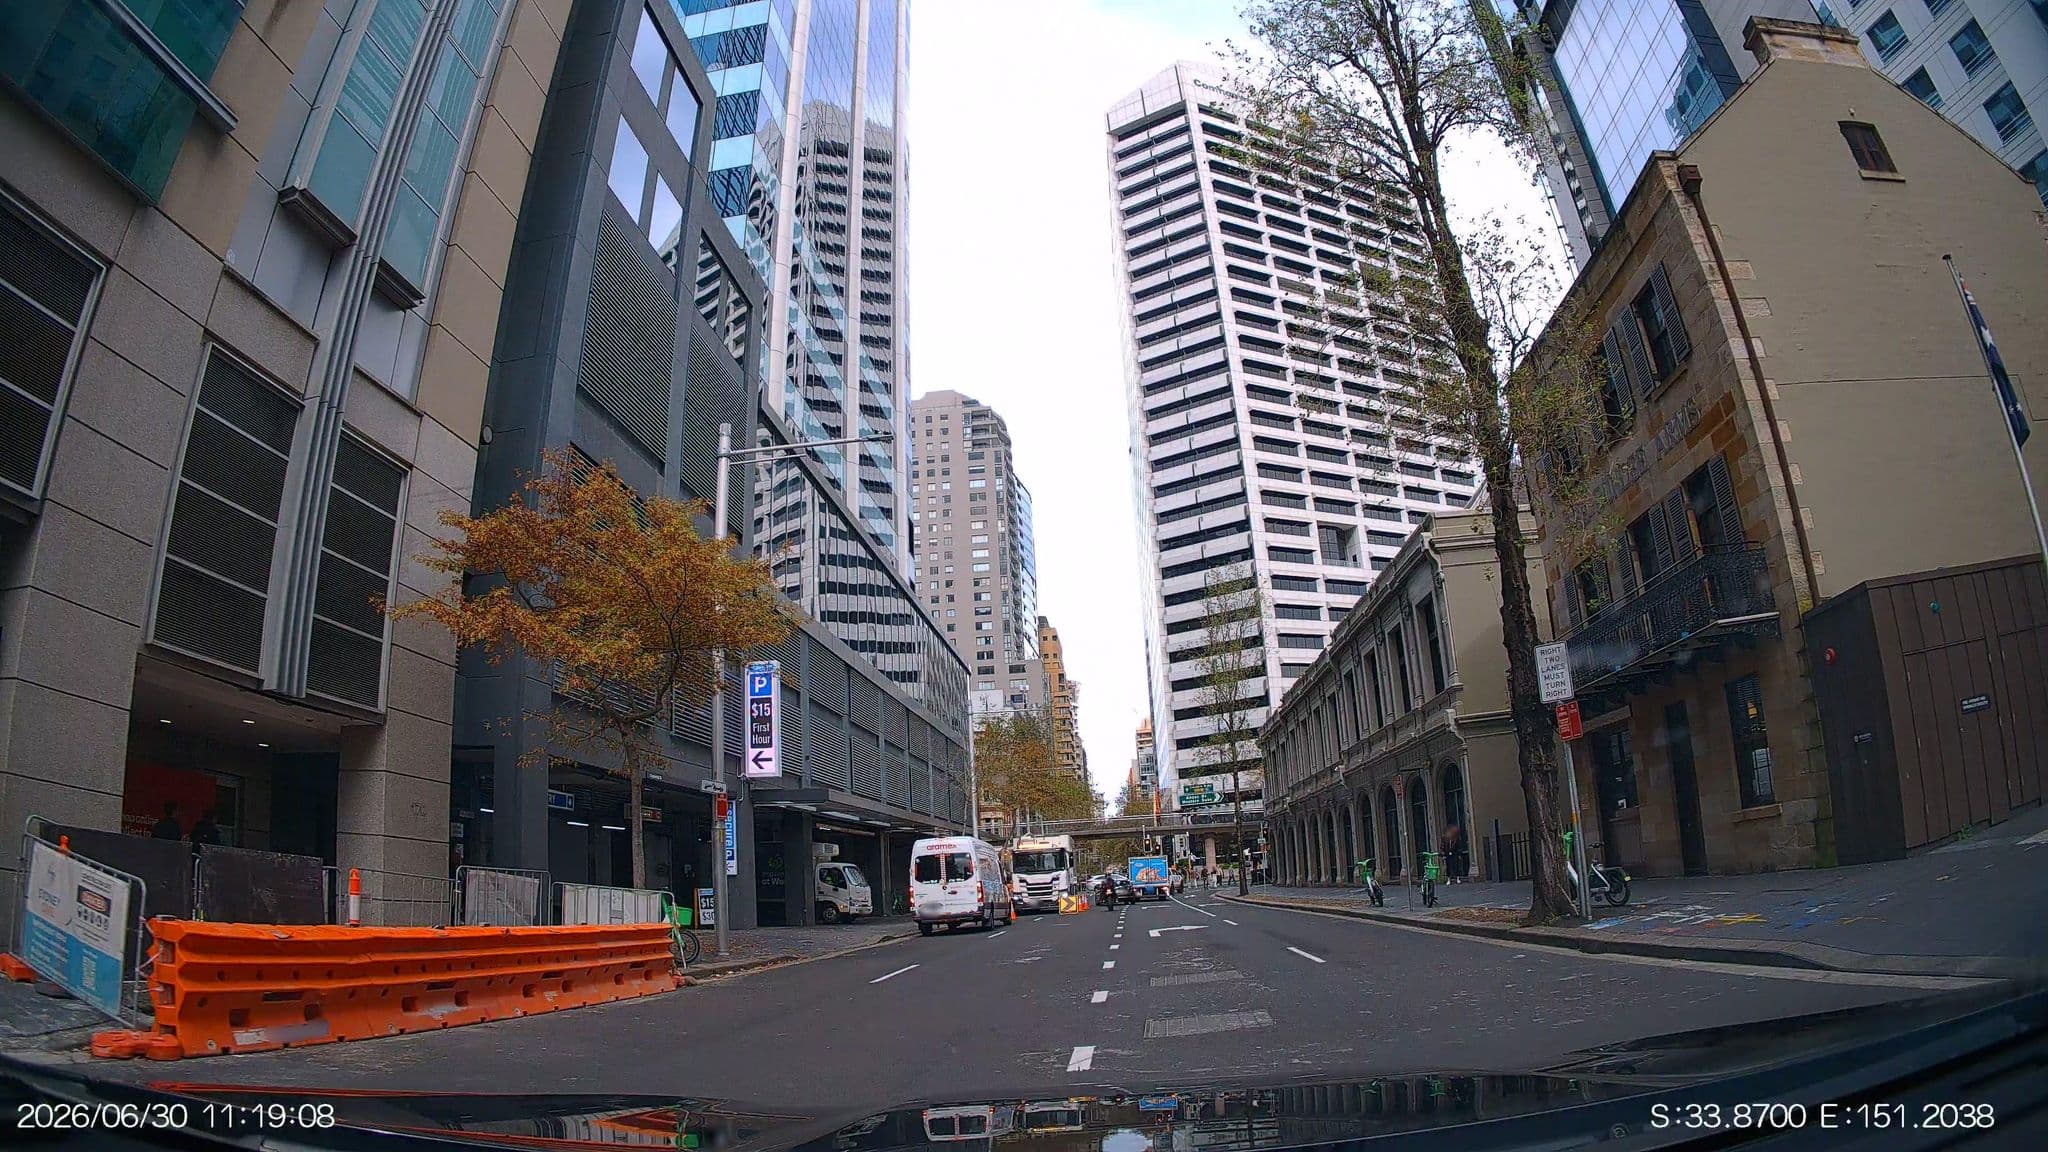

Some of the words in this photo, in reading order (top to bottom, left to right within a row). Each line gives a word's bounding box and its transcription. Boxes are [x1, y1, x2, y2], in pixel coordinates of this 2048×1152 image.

[1540, 647, 1561, 656] RIGHT
[1544, 656, 1560, 664] TWO
[1541, 663, 1566, 673] LANES
[1544, 672, 1565, 681] MUST
[754, 677, 767, 693] P
[1546, 681, 1566, 689] TURN
[1546, 689, 1567, 697] RIGHT
[751, 703, 771, 718] $15
[752, 723, 770, 732] First
[752, 735, 771, 744] Hour
